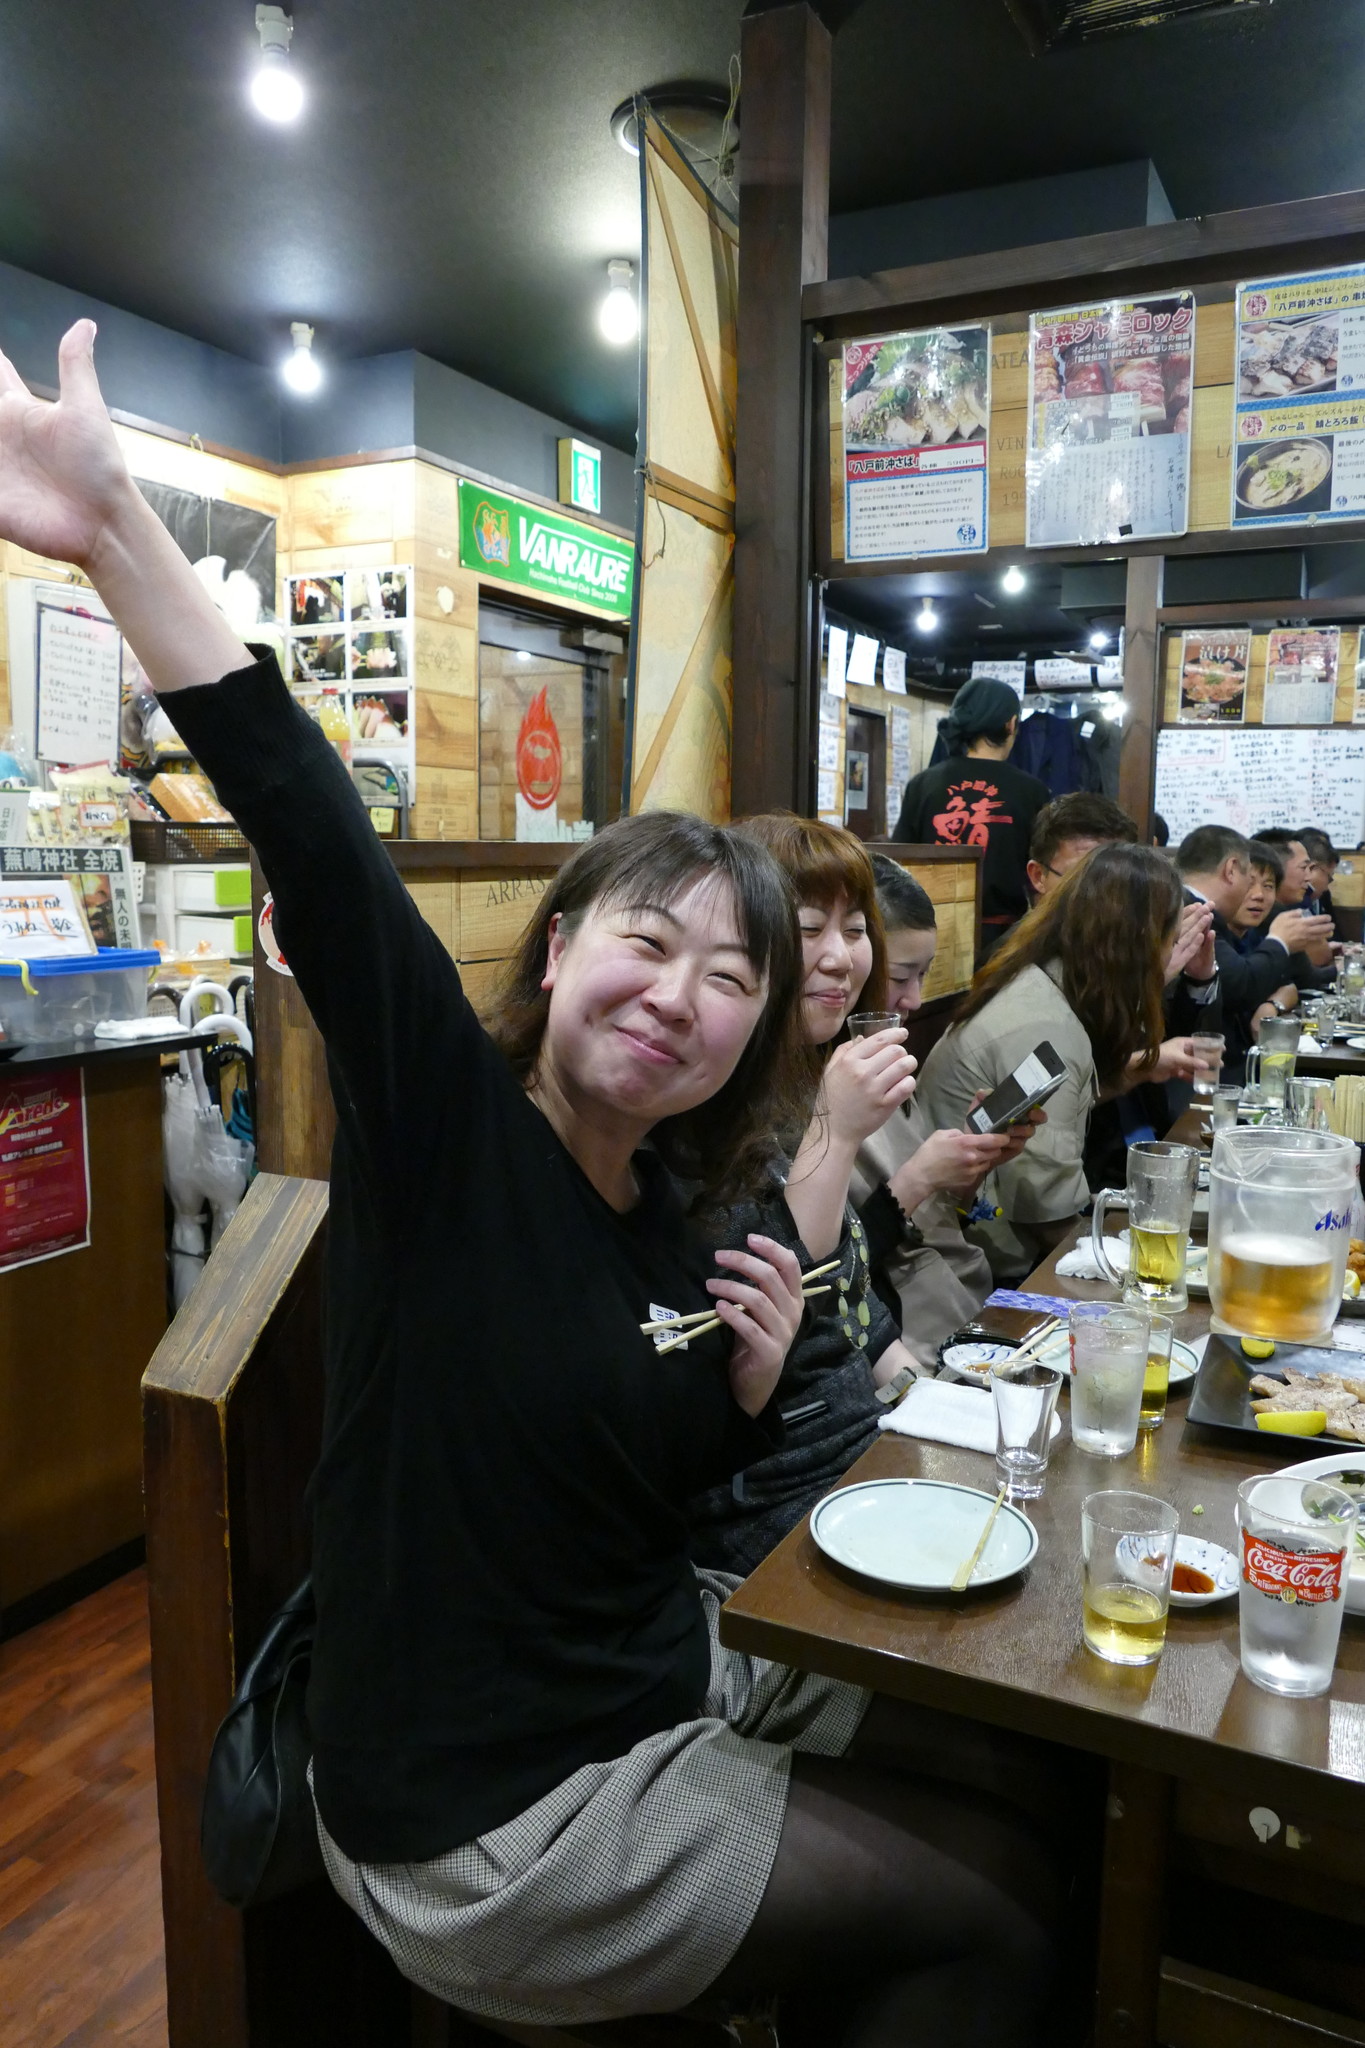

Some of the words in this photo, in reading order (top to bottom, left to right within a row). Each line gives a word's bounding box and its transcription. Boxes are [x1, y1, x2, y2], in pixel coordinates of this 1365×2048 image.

[1036, 307, 1192, 349] 青森シャモロック
[848, 456, 919, 474] 「八戸前沖さば」
[519, 516, 631, 593] VANRAURE
[578, 582, 590, 595] Club
[83, 849, 120, 872] 全焼
[1255, 1542, 1284, 1558] DELICIOUS
[1293, 1555, 1330, 1563] REFRESHING
[1247, 1547, 1340, 1587] Coca-Cola
